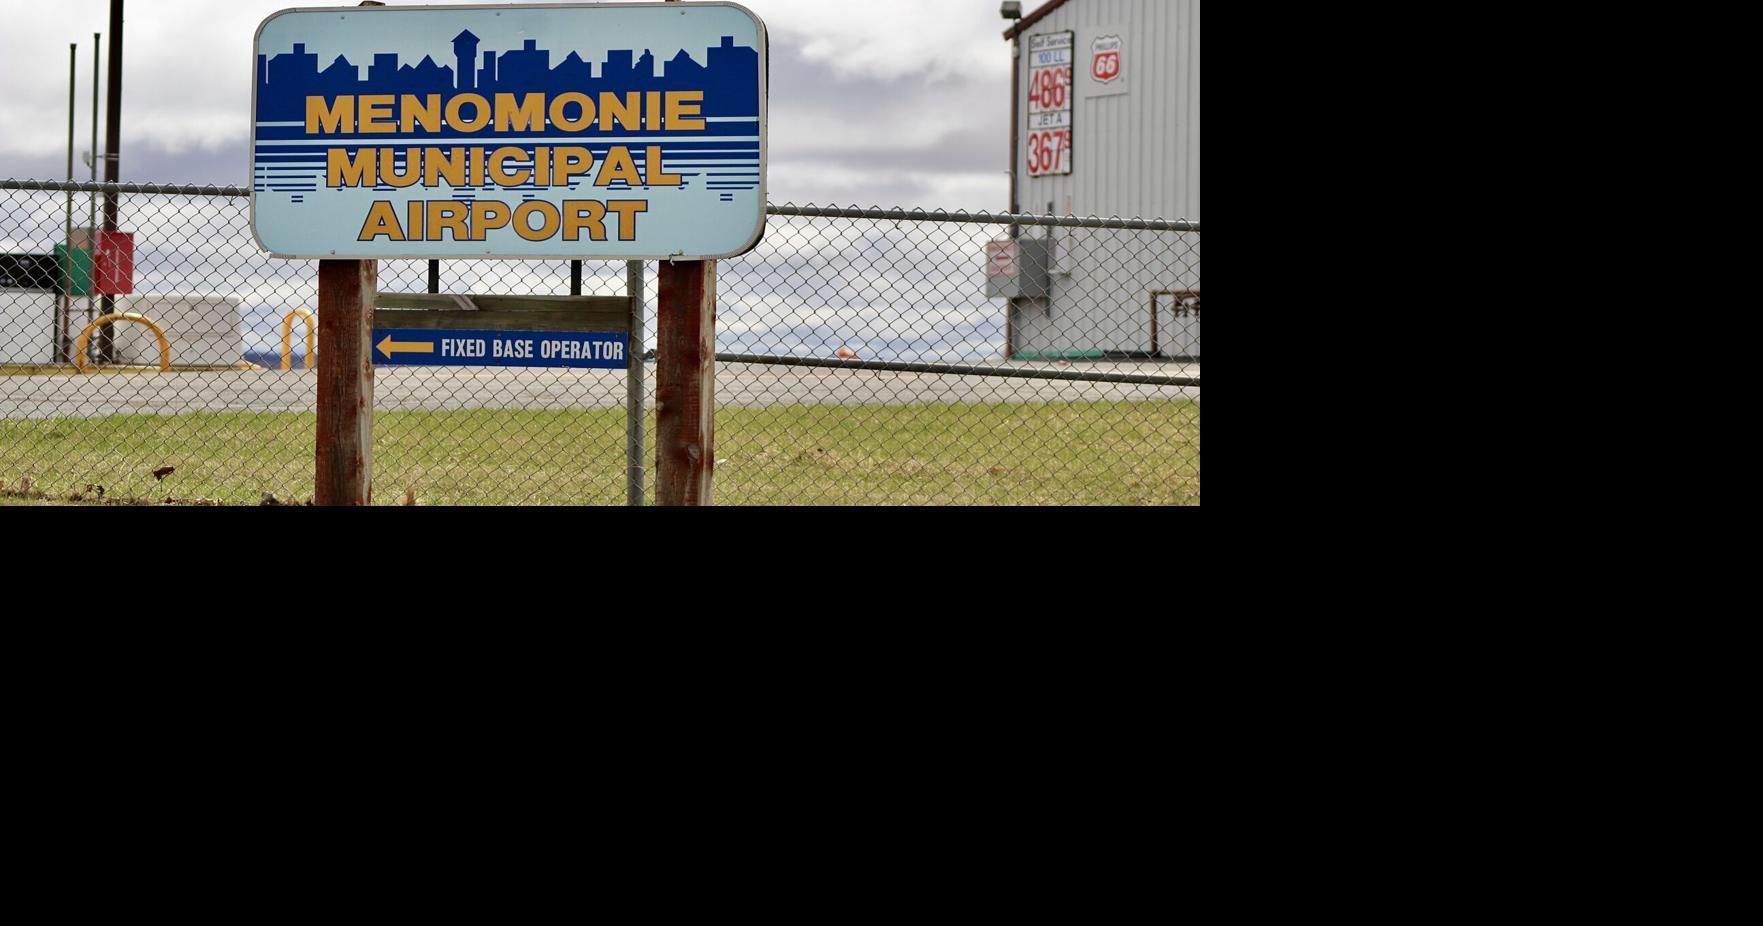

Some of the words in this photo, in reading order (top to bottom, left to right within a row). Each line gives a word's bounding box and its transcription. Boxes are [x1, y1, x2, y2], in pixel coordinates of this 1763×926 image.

[1039, 53, 1051, 64] 100
[1054, 52, 1064, 62] LL
[1096, 54, 1116, 74] 66
[304, 90, 706, 134] MENOMONIE
[1038, 113, 1054, 125] JET
[1055, 112, 1062, 124] A
[325, 145, 683, 188] MUNICIPAL
[357, 199, 649, 242] AIRPORT
[441, 338, 486, 357] FIXED
[493, 339, 533, 358] BASE
[540, 340, 624, 361] OPERATOR
